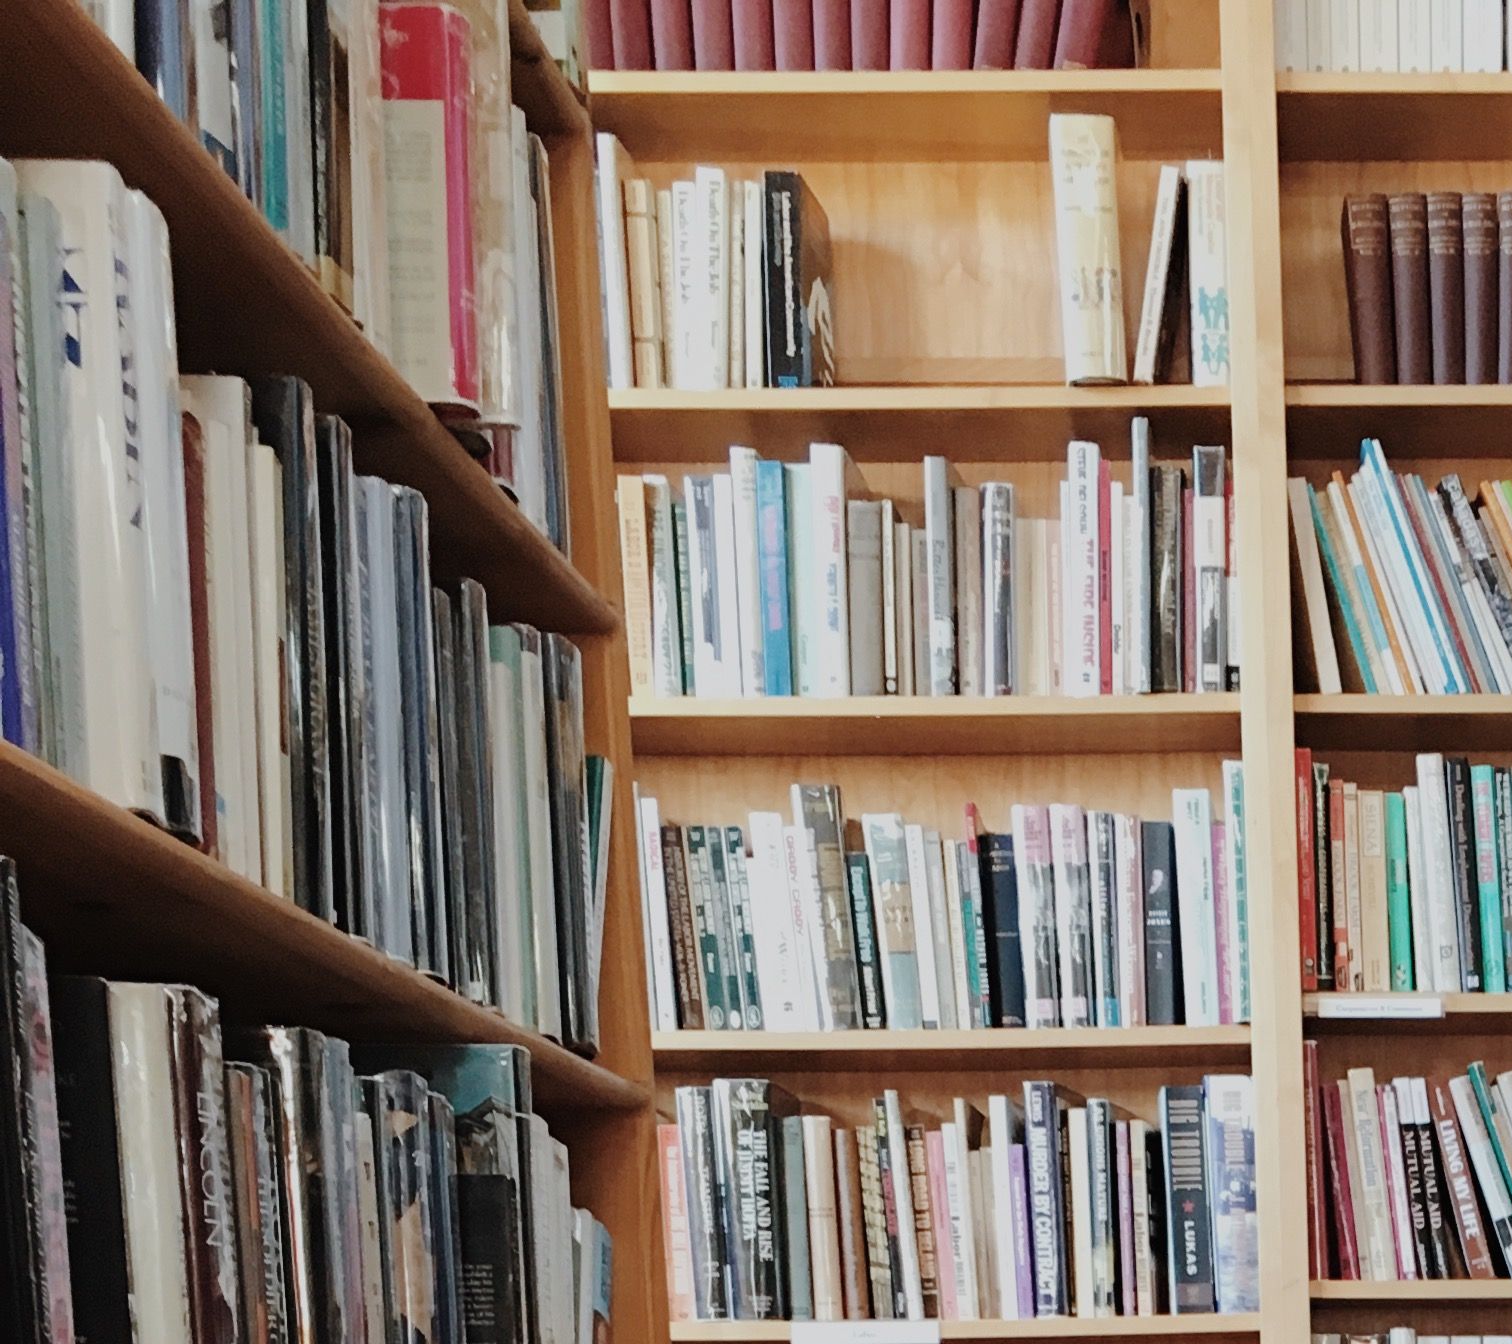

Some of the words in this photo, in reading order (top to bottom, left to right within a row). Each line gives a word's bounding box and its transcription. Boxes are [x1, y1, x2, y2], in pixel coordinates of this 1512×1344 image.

[1365, 803, 1377, 850] SIENA
[1168, 1100, 1200, 1123] BIG
[1171, 1131, 1203, 1191] TROUBLE
[1402, 1129, 1420, 1199] MUTUAL
[1419, 1129, 1437, 1199] MUTUAL
[1440, 1120, 1465, 1173] LIVING
[196, 1090, 223, 1248] LINCOLN
[754, 1162, 771, 1194] FALL
[1452, 1178, 1470, 1201] MY
[757, 1198, 772, 1228] AND
[1410, 1200, 1426, 1231] AID
[1427, 1200, 1442, 1231] AID
[1460, 1204, 1481, 1241] LIFE
[758, 1230, 774, 1263] RISE
[1183, 1219, 1199, 1275] LUKAS
